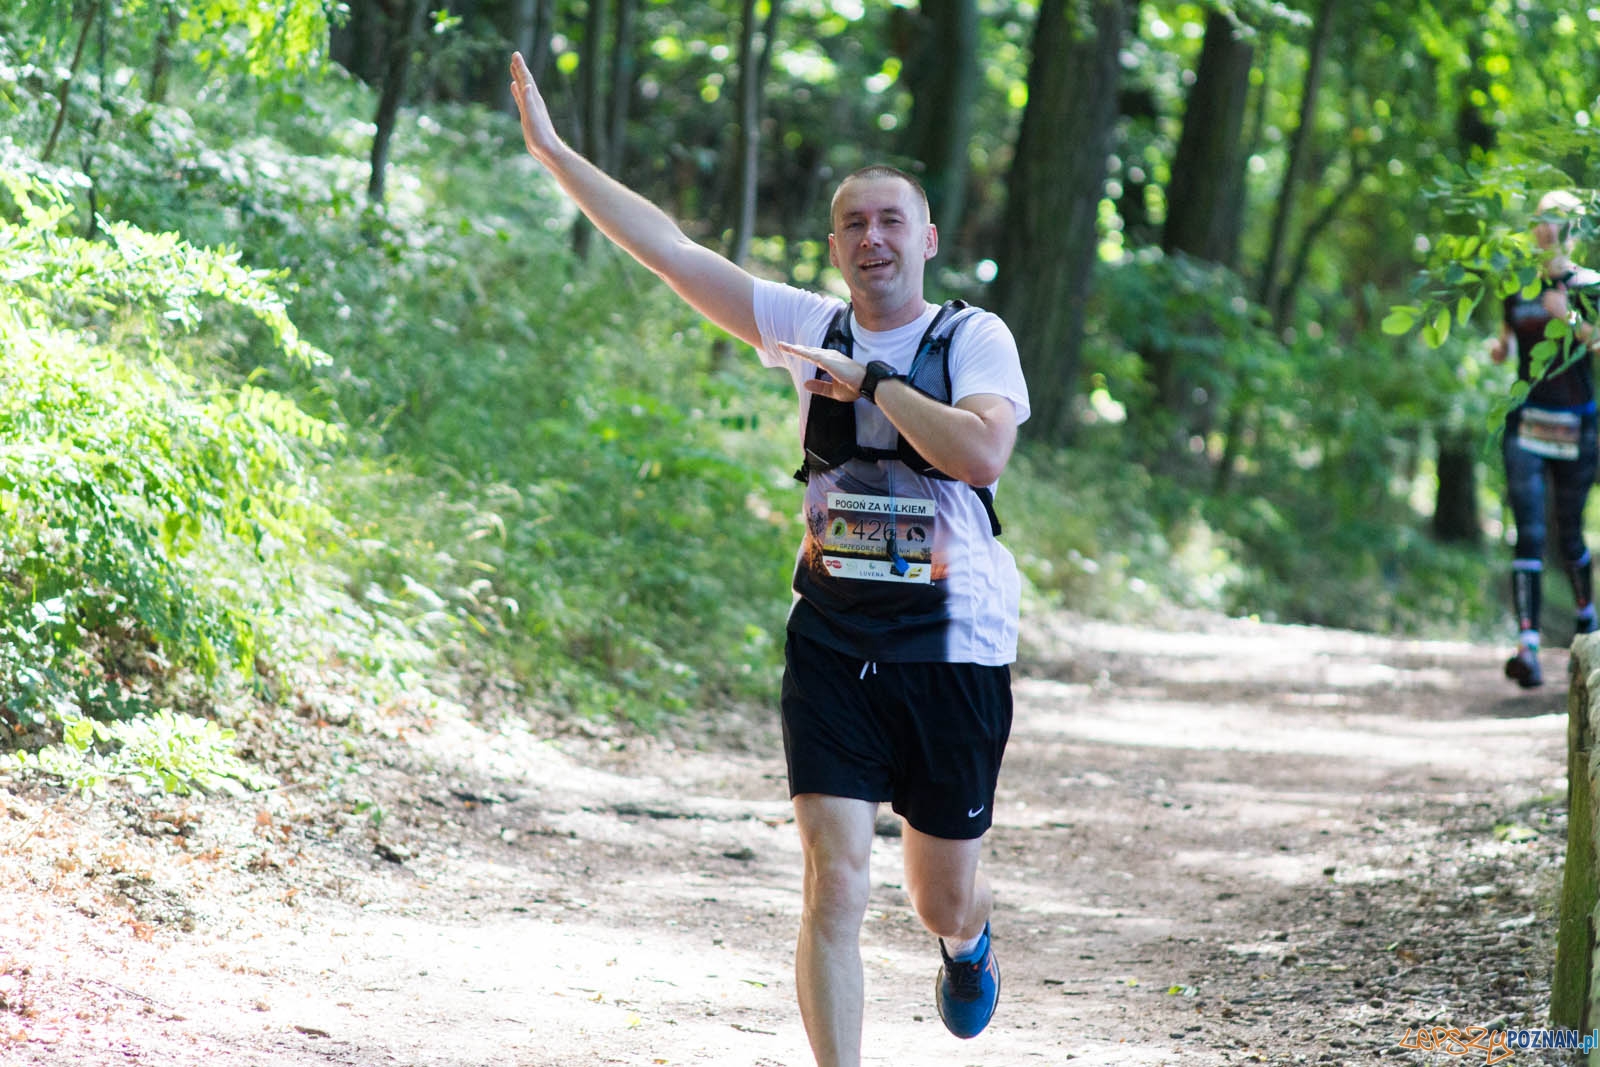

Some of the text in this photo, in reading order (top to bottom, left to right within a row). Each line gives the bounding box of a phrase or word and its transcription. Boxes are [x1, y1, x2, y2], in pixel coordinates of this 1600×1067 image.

[835, 499, 866, 510] POGOŃ
[867, 502, 881, 511] ZA
[852, 519, 897, 542] 426
[839, 543, 874, 552] GRZEGORZ
